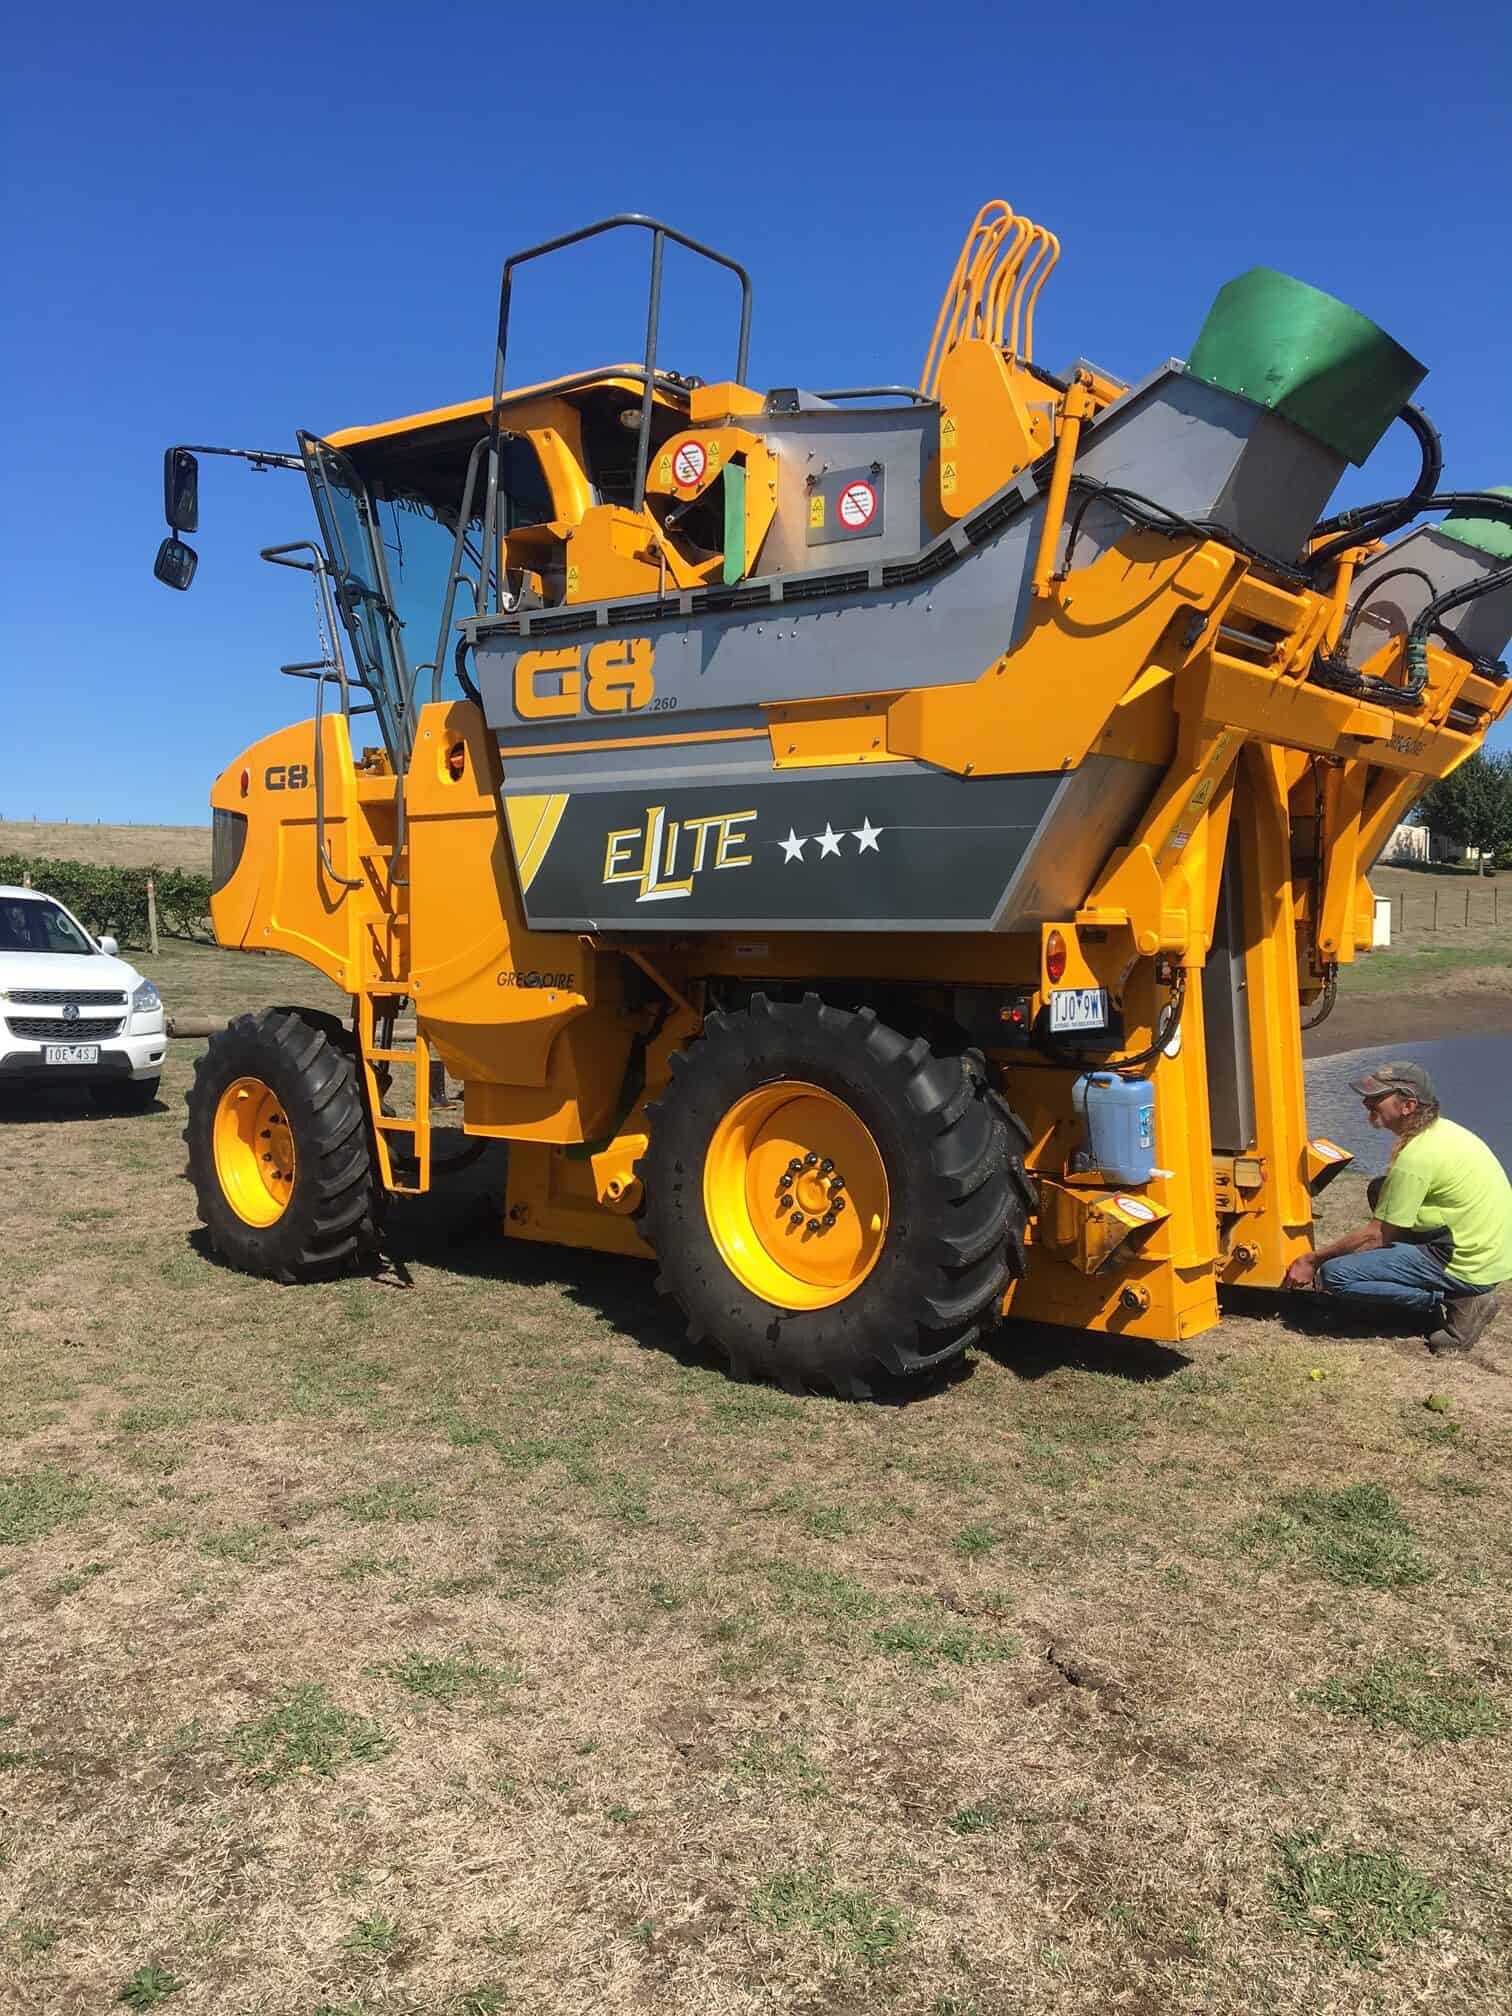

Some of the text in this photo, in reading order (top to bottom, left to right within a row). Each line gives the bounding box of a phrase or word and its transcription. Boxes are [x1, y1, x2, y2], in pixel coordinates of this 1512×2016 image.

[512, 637, 655, 722] G8
[265, 764, 308, 791] G8
[497, 970, 576, 990] GREGOIRE
